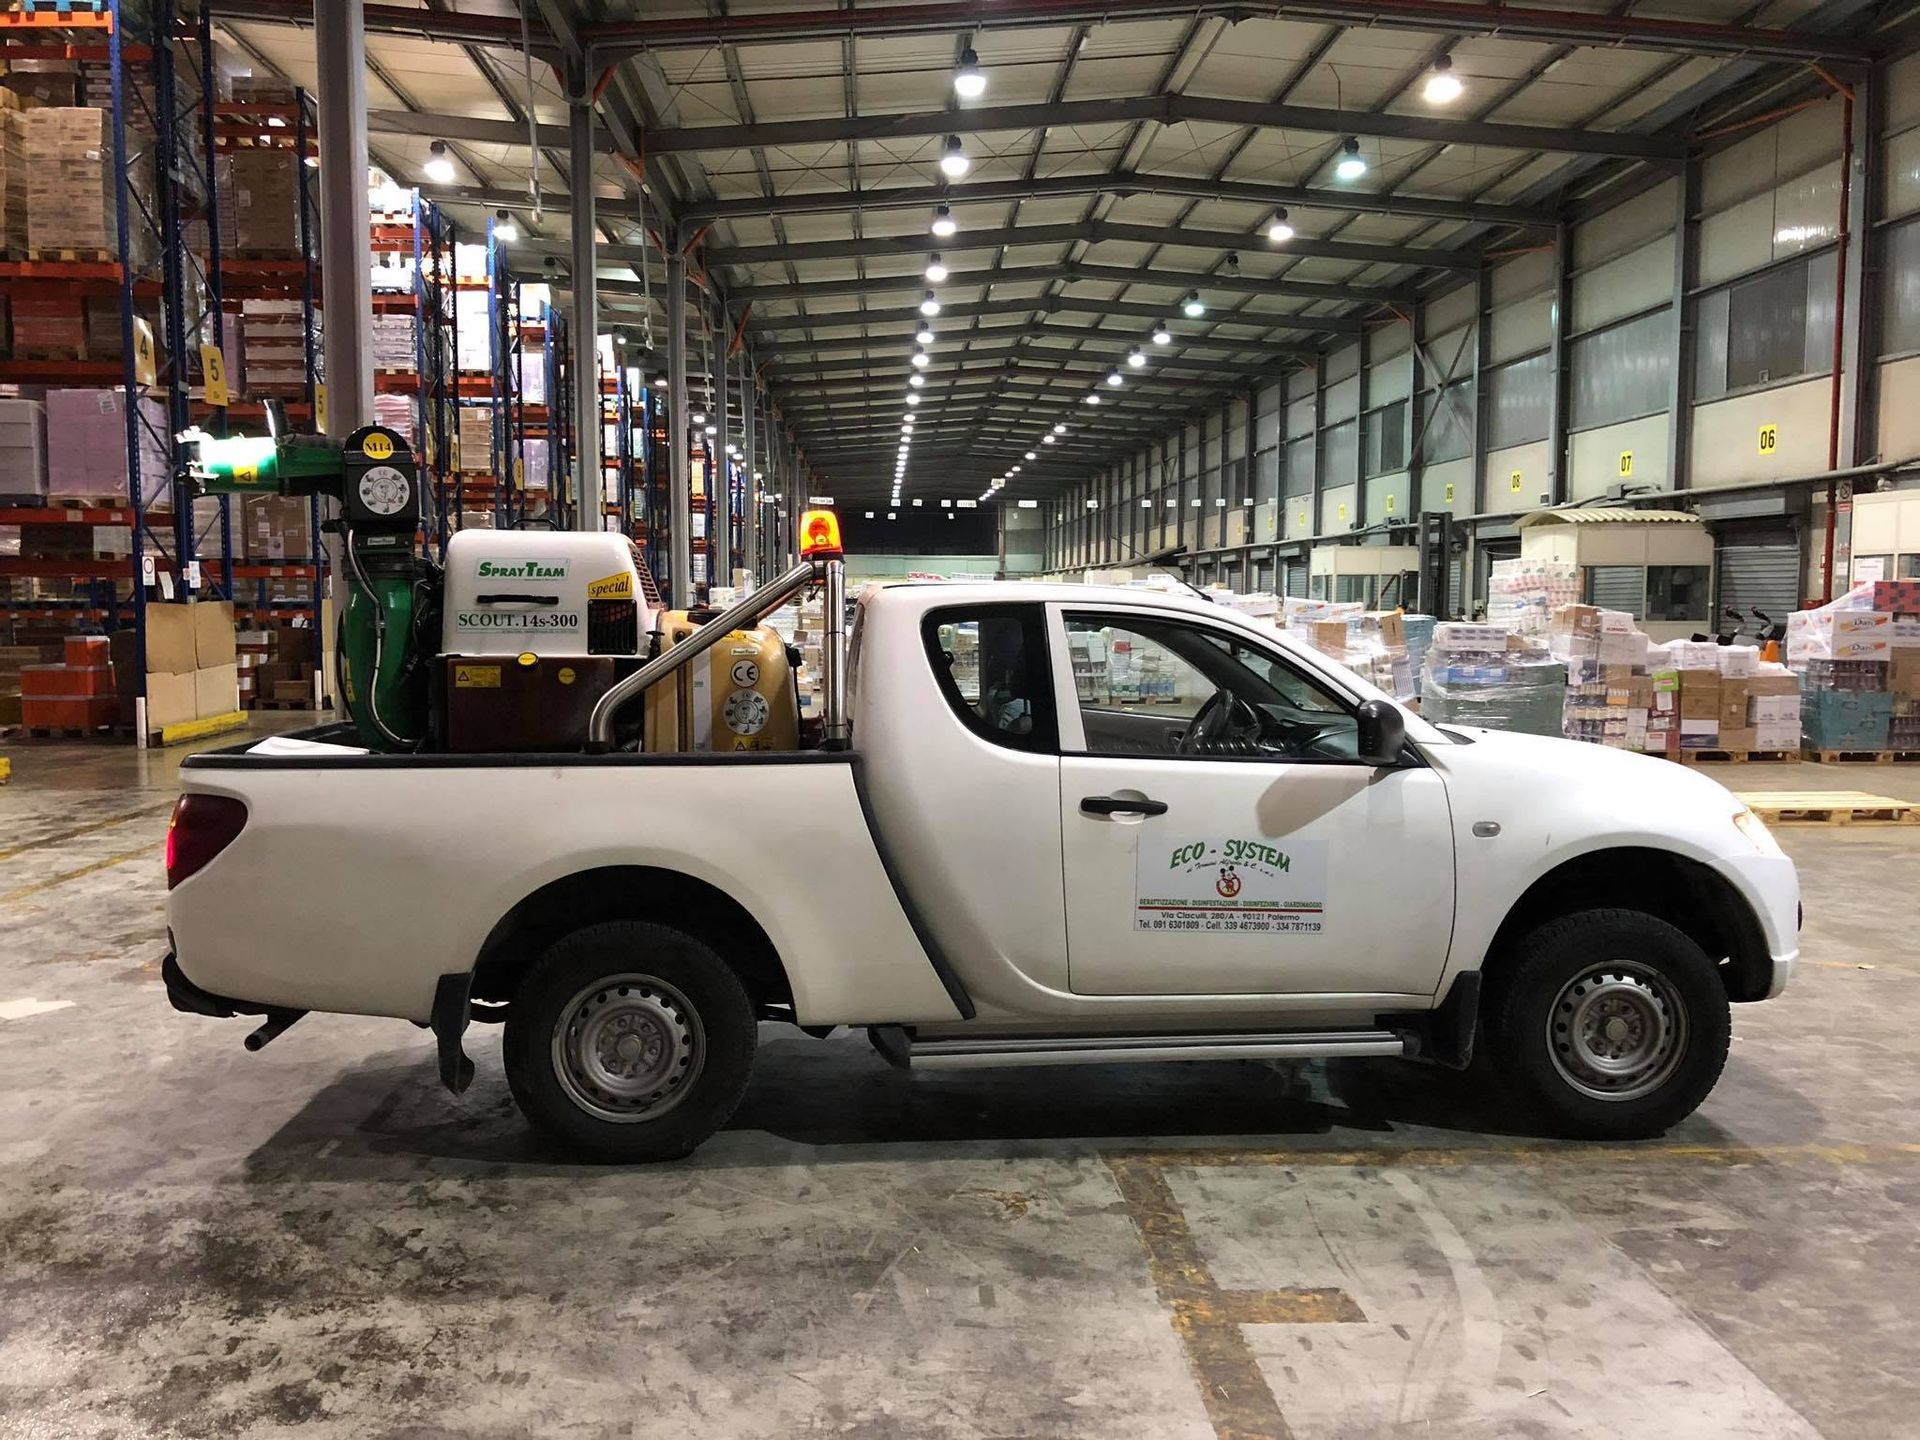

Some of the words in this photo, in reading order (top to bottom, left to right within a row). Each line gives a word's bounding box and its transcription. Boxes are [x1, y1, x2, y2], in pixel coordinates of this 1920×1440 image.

[139, 335, 149, 360] 4
[209, 358, 219, 382] 5
[318, 395, 324, 414] 5
[365, 442, 392, 453] M14
[1760, 429, 1775, 450] 06
[1620, 455, 1632, 472] 07
[1511, 474, 1521, 488] 08
[589, 575, 631, 597] special
[733, 665, 756, 681] CE
[1169, 841, 1206, 869] ECO
[1223, 839, 1291, 872] SYSTEM
[1138, 920, 1150, 928] Tel.
[1153, 920, 1166, 929] 091
[1205, 921, 1222, 930] Cell.
[1224, 922, 1237, 930] 339
[1276, 923, 1289, 931] 334
[1291, 923, 1321, 931] 7871139
